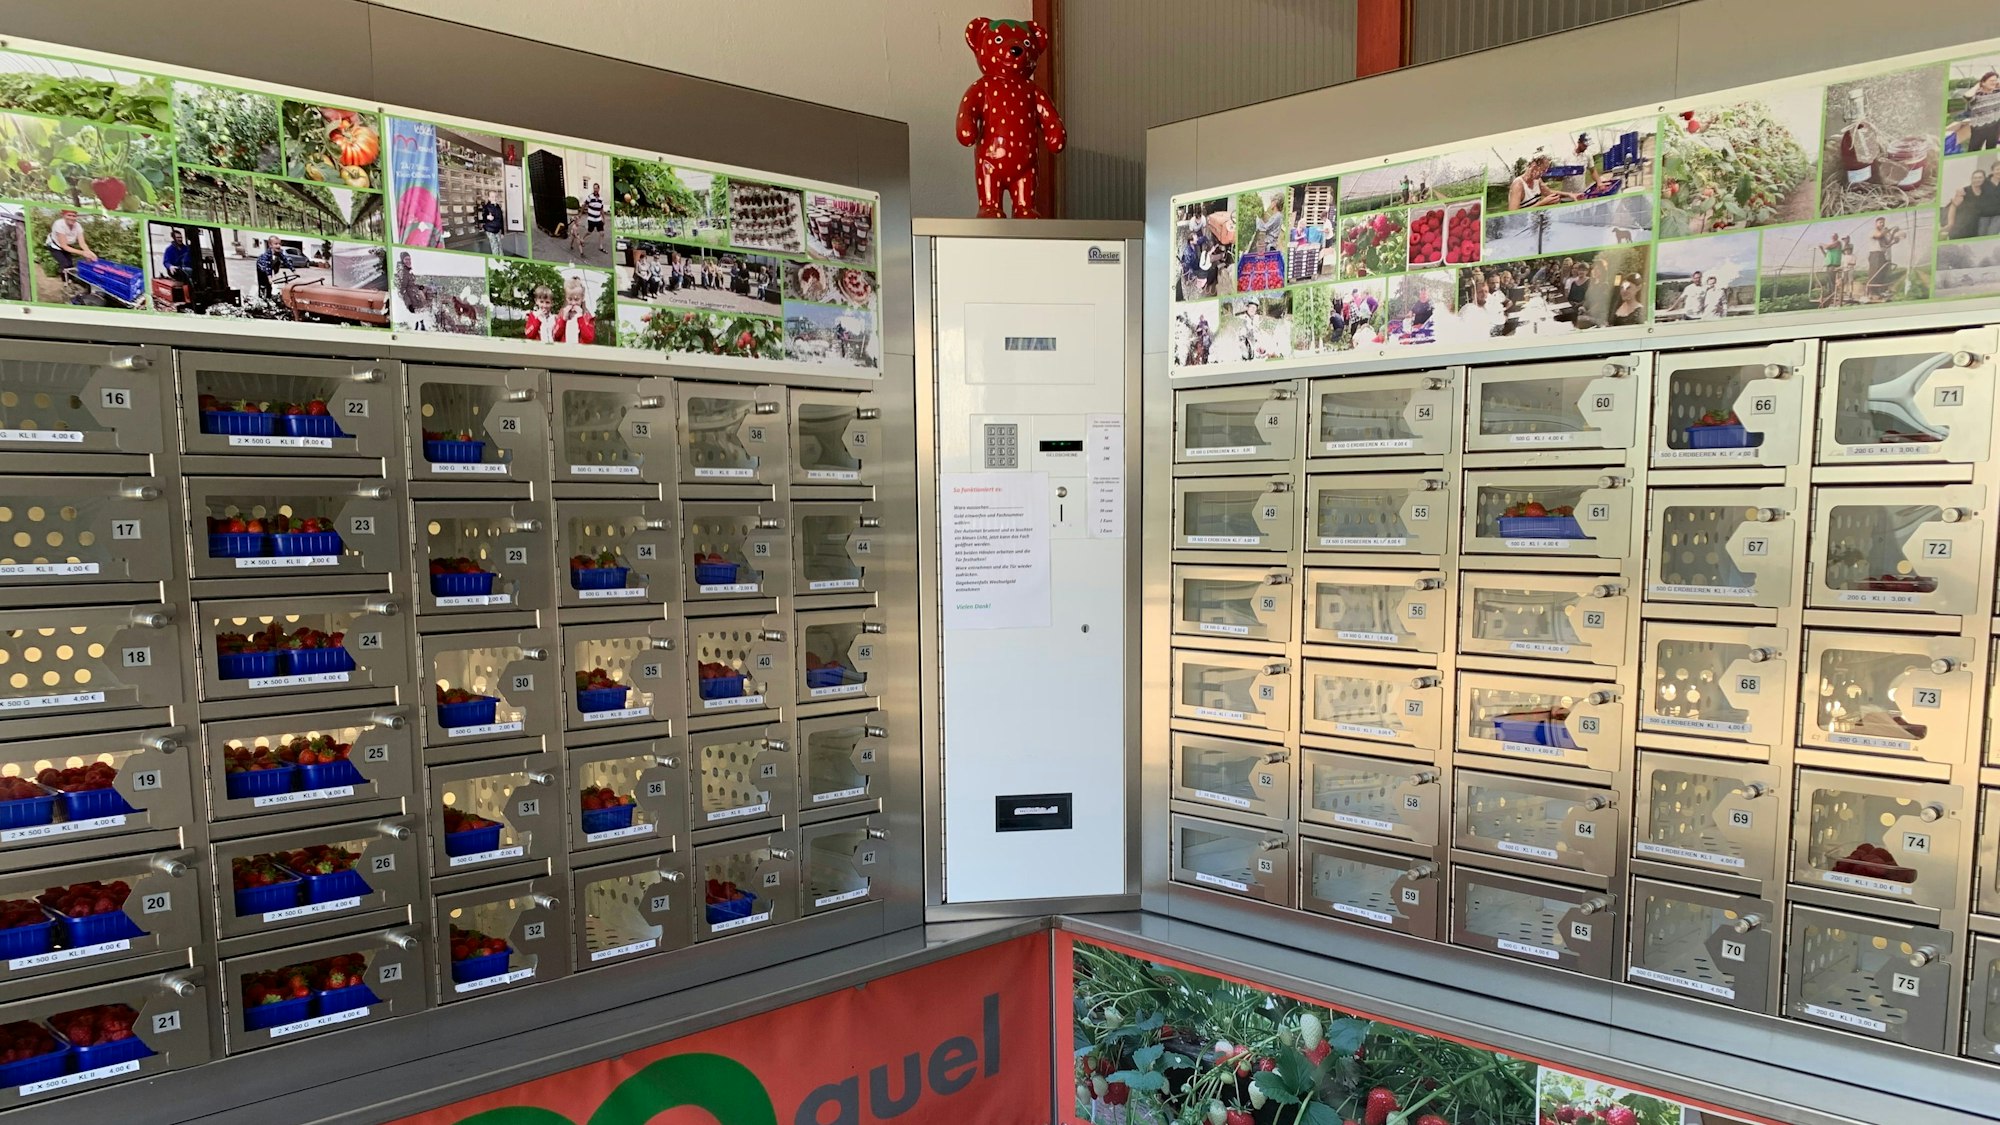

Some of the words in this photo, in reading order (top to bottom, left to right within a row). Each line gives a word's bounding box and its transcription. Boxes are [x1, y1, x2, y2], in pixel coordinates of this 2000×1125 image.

[106, 392, 124, 405] 16
[1941, 390, 1958, 403] 71
[1596, 397, 1610, 408] 60
[1756, 400, 1771, 411] 66
[349, 402, 364, 414] 22
[1419, 408, 1430, 418] 54
[502, 419, 515, 430] 28
[1268, 416, 1278, 426] 48
[636, 425, 648, 435] 33
[752, 430, 762, 440] 38
[855, 434, 865, 444] 43
[1266, 508, 1275, 518] 49
[1415, 508, 1426, 517] 55
[1593, 507, 1605, 517] 61
[117, 524, 134, 535] 17
[355, 520, 369, 531] 23
[756, 544, 766, 554] 39
[858, 542, 868, 551] 44
[1748, 541, 1763, 552] 67
[1929, 543, 1946, 555] 72
[509, 551, 522, 561] 29
[640, 547, 651, 557] 34
[1264, 599, 1273, 608] 50
[1412, 606, 1423, 616] 56
[1587, 614, 1601, 625] 62
[363, 635, 377, 646] 24
[128, 651, 145, 663] 18
[860, 648, 870, 658] 45
[760, 656, 770, 667] 40
[645, 666, 657, 676] 35
[516, 678, 529, 688] 30
[1741, 679, 1756, 690] 68
[1263, 687, 1272, 696] 51
[1919, 692, 1936, 704] 73
[1409, 703, 1420, 712] 57
[1583, 720, 1596, 730] 63
[1667, 720, 1704, 728] ERDBEEREN
[369, 749, 383, 759] 25
[863, 751, 872, 761] 46
[764, 766, 773, 776] 41
[138, 774, 155, 786] 19
[1261, 775, 1271, 785] 52
[650, 784, 661, 793] 36
[523, 802, 536, 812] 31
[1407, 797, 1418, 808] 58
[1734, 813, 1748, 824] 69
[1579, 824, 1592, 835] 64
[1907, 836, 1925, 849] 74
[864, 853, 873, 862] 47
[376, 858, 390, 869] 26
[1261, 861, 1270, 871] 53
[766, 874, 776, 884] 42
[1873, 882, 1888, 890] 3,00
[1405, 890, 1416, 901] 59
[147, 897, 164, 910] 20
[654, 898, 665, 909] 37
[529, 925, 541, 936] 32
[1575, 925, 1588, 937] 65
[1726, 944, 1741, 956] 70
[383, 967, 397, 979] 27
[1898, 977, 1915, 990] 75
[158, 1015, 175, 1028] 21
[1857, 1018, 1871, 1027] 3,00
[46, 1080, 60, 1088] 500
